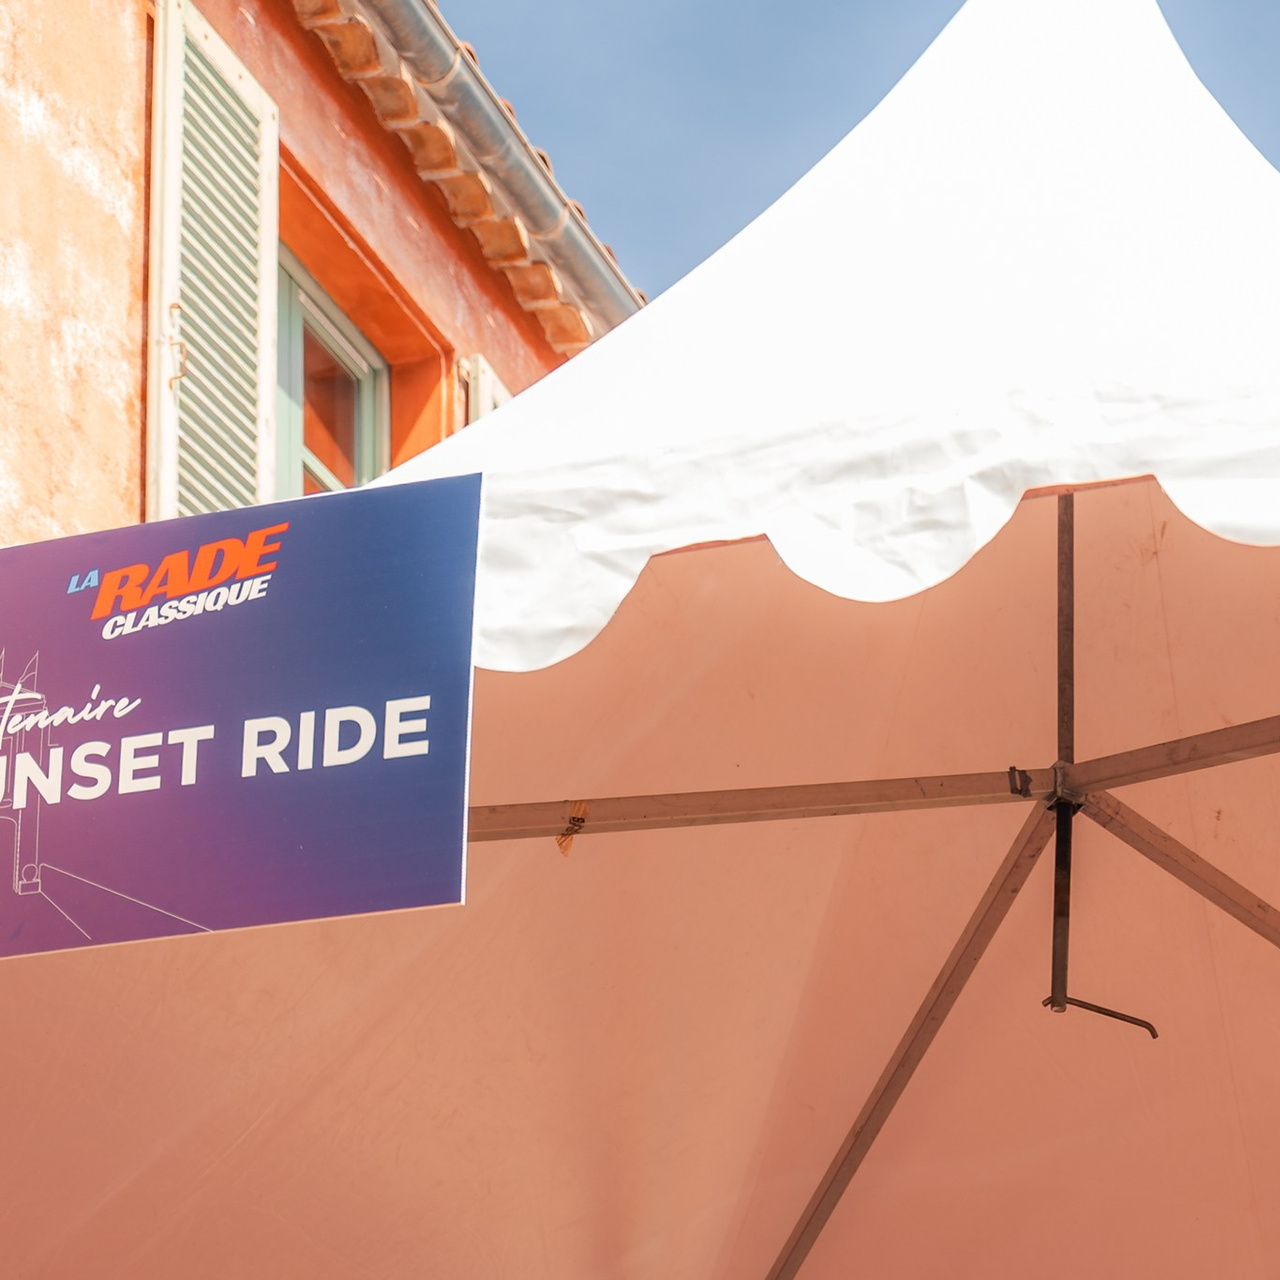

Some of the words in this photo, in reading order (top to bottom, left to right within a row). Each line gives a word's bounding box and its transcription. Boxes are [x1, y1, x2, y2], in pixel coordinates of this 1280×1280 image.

[67, 569, 99, 594] LA
[90, 522, 290, 621] RADE
[101, 574, 272, 640] CLASSIQUE
[0, 725, 215, 810] NSET
[241, 695, 431, 778] RIDE
